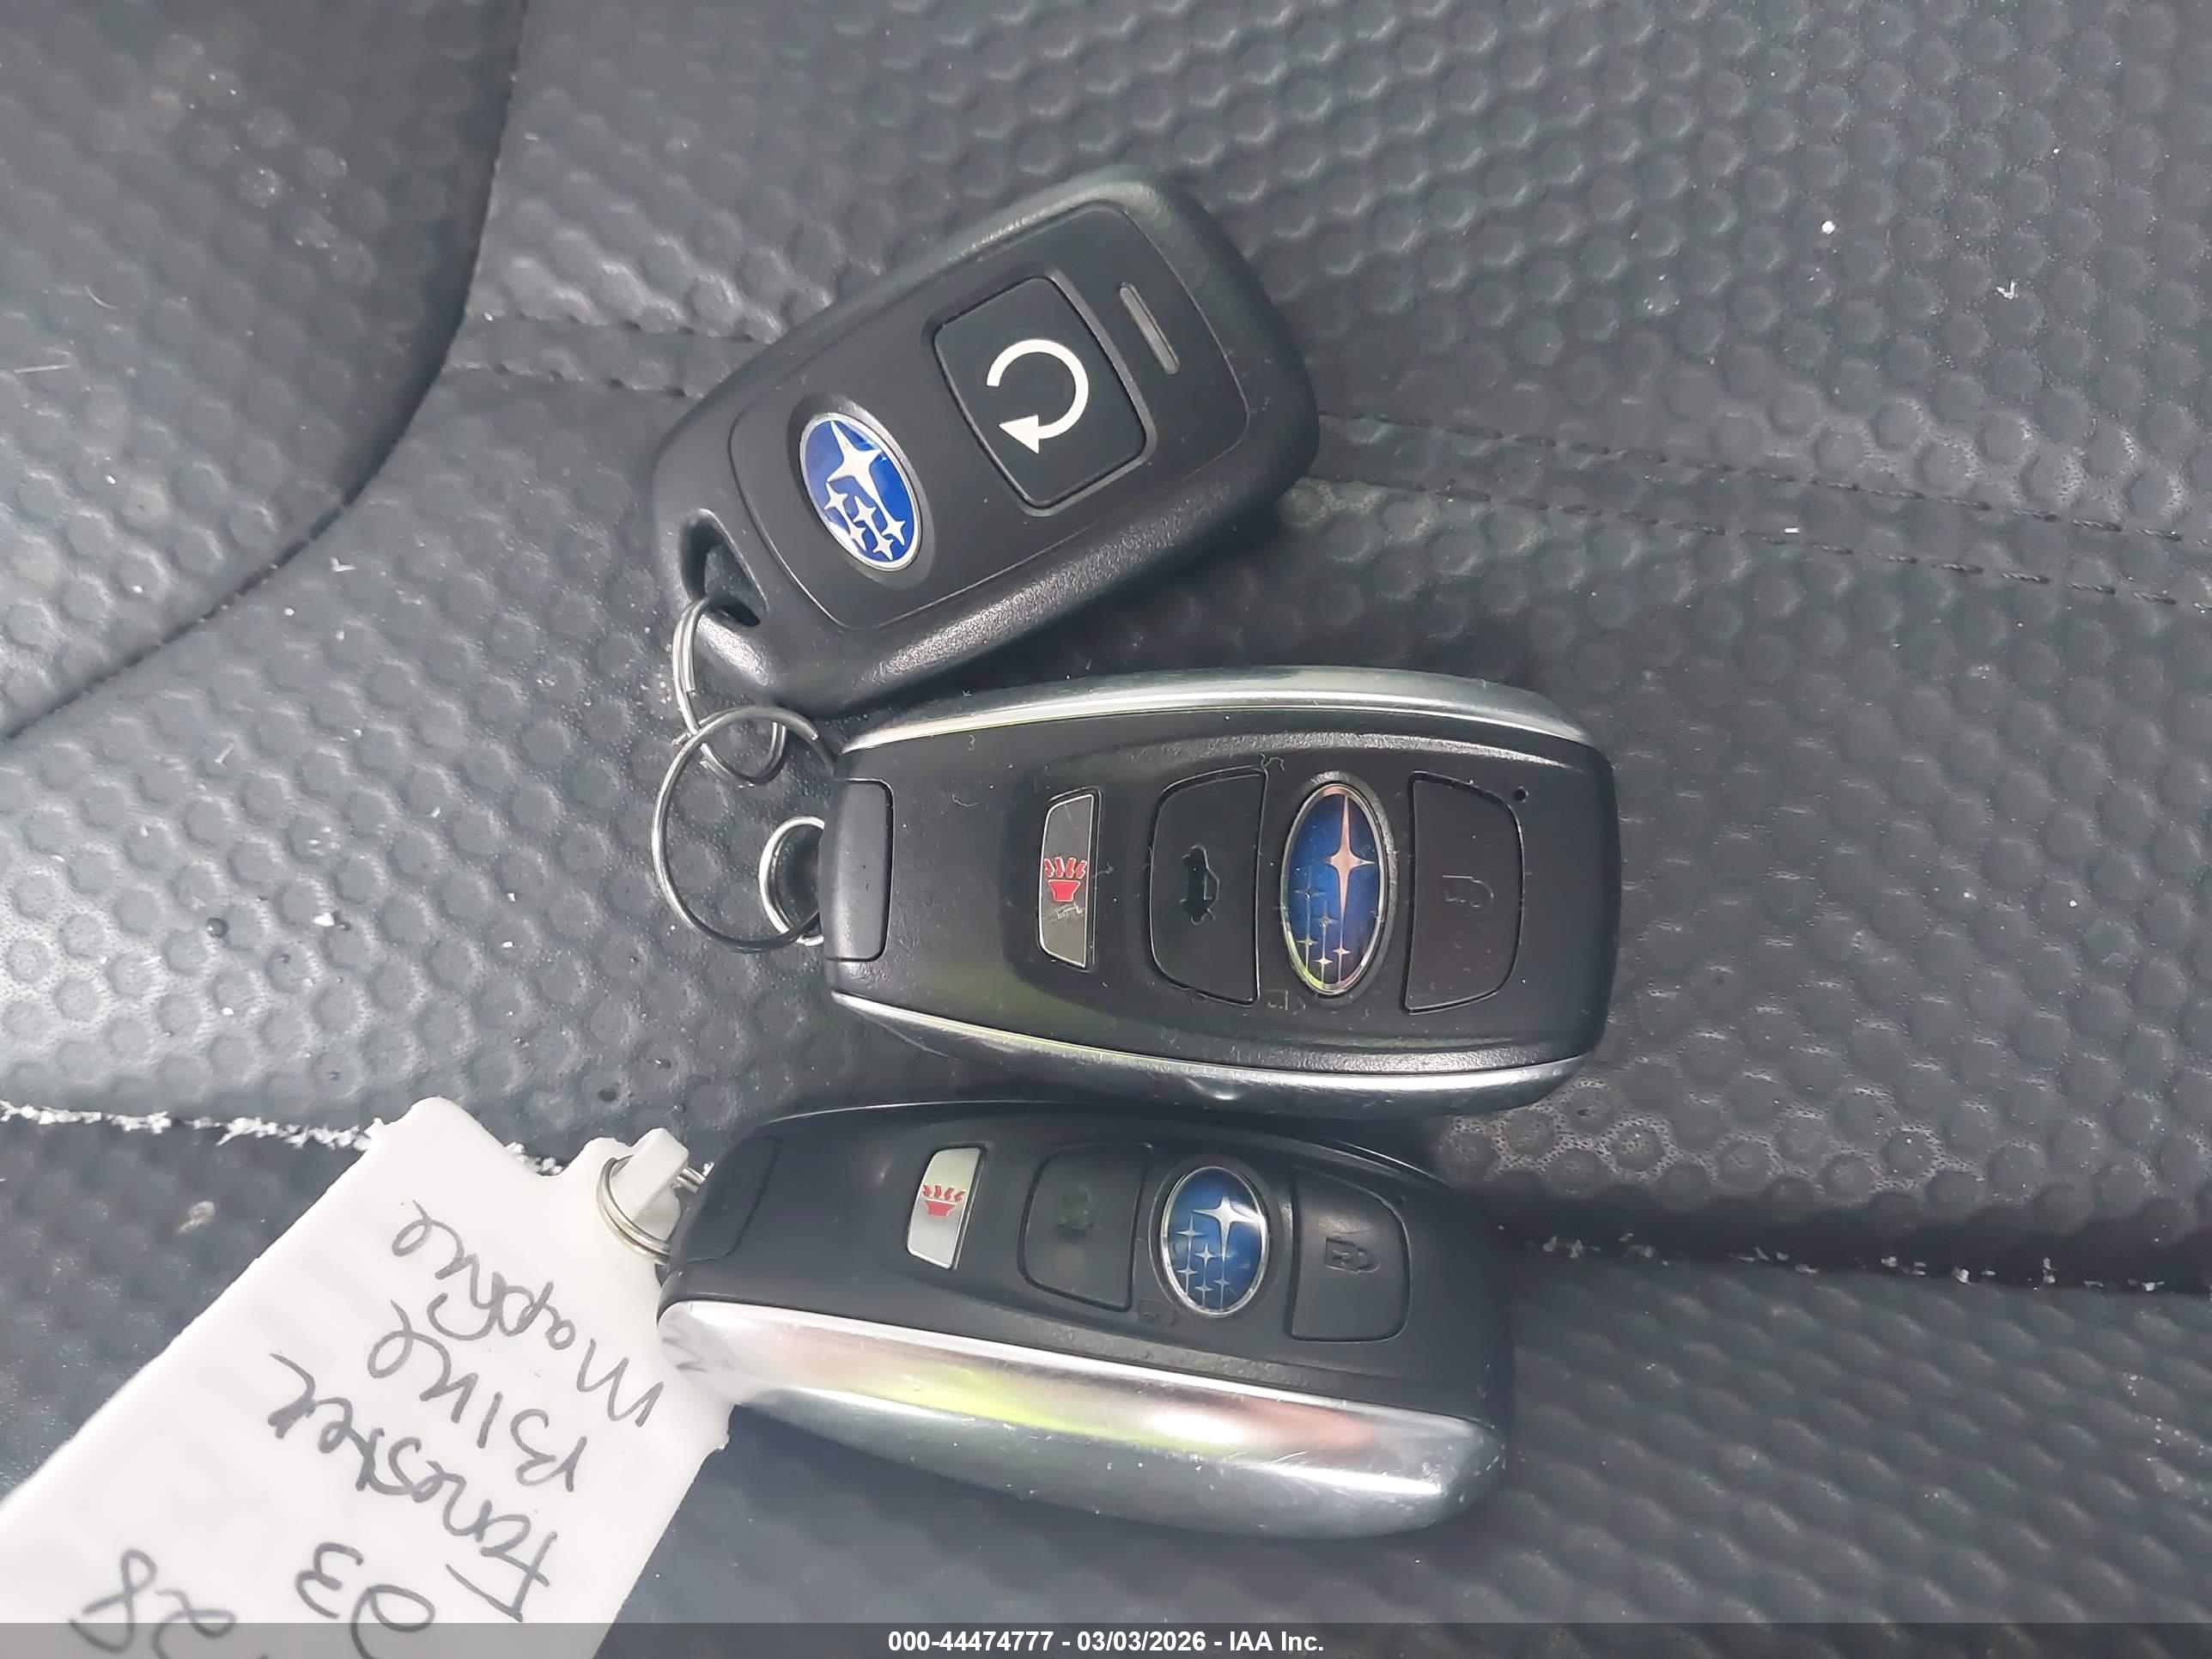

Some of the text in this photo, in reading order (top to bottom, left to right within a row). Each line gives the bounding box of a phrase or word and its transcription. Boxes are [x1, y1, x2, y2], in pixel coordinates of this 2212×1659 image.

[267, 1353, 558, 1623] Forester
[367, 1298, 588, 1493] Blue
[295, 1540, 436, 1659] 23
